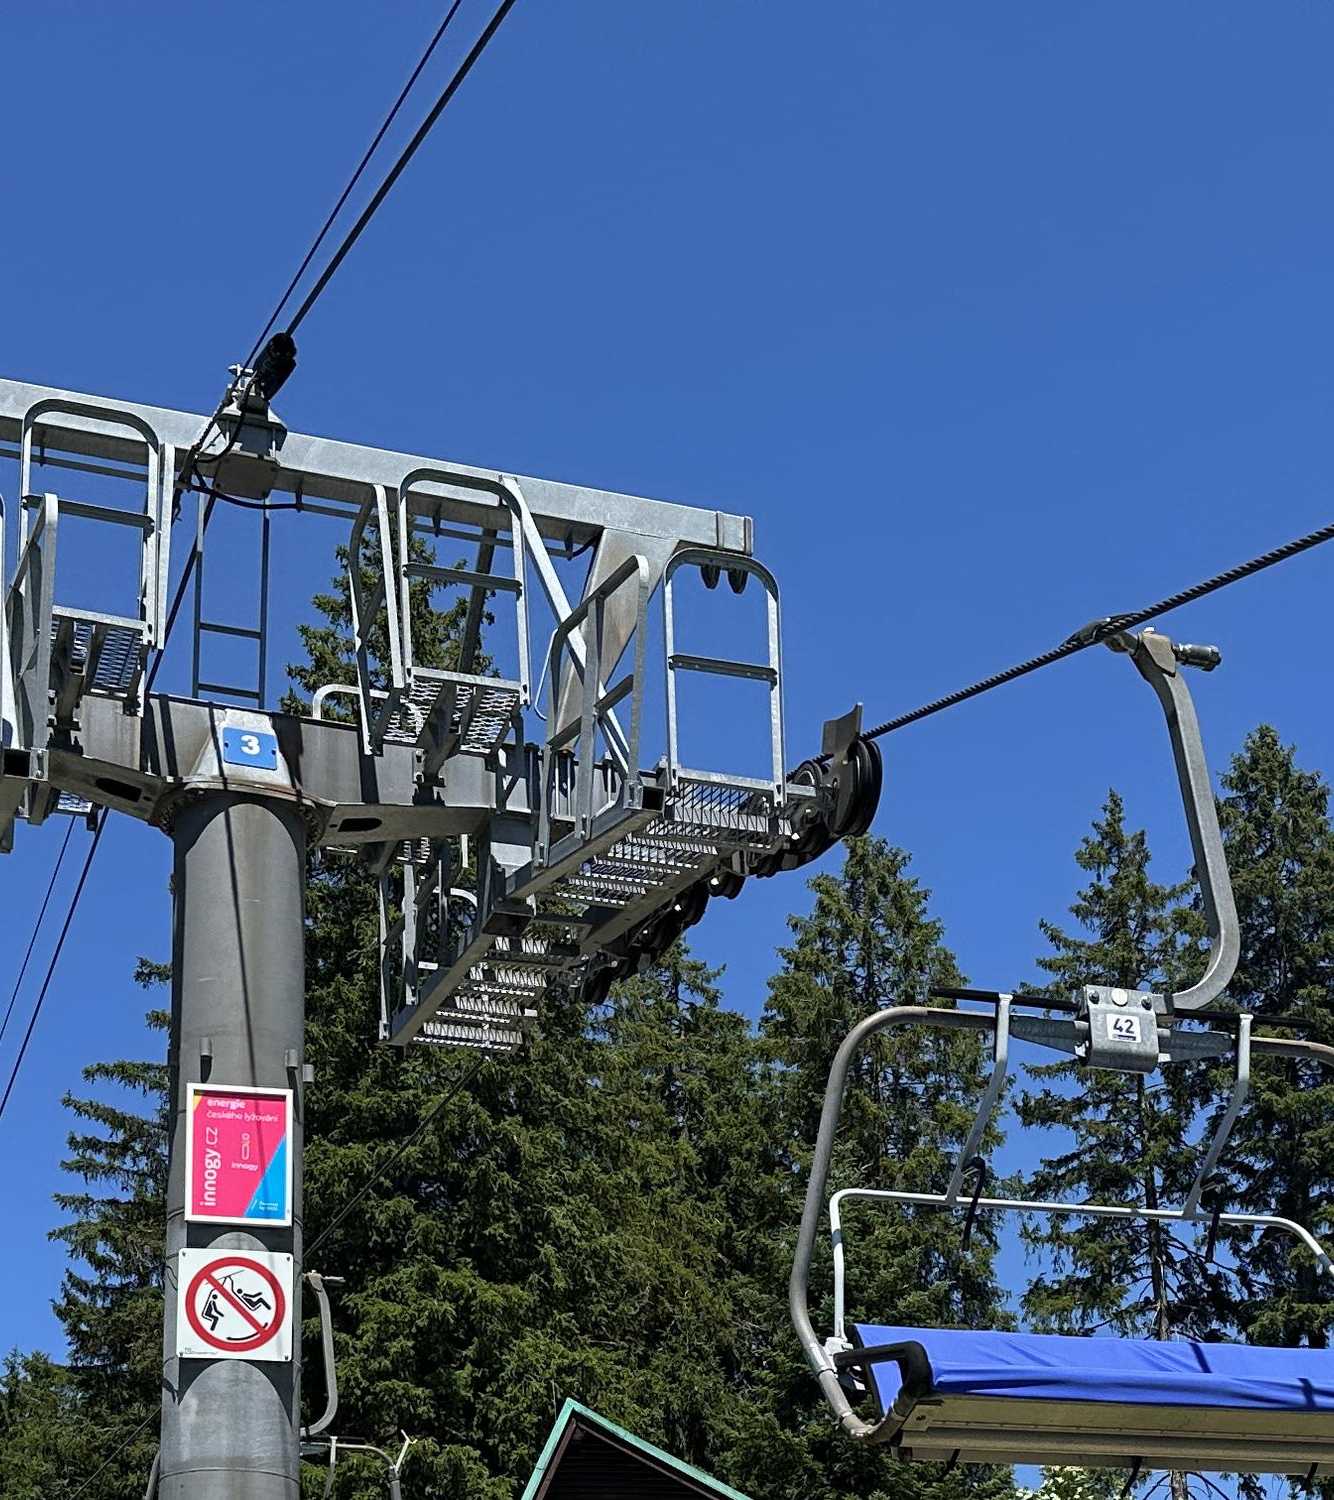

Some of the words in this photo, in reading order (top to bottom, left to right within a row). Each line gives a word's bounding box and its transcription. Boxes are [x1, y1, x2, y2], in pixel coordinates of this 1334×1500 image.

[241, 735, 261, 755] 3
[1113, 1018, 1135, 1034] 42
[207, 1098, 245, 1110] energie
[199, 1127, 221, 1206] innogy.cz
[231, 1161, 259, 1172] innogy
